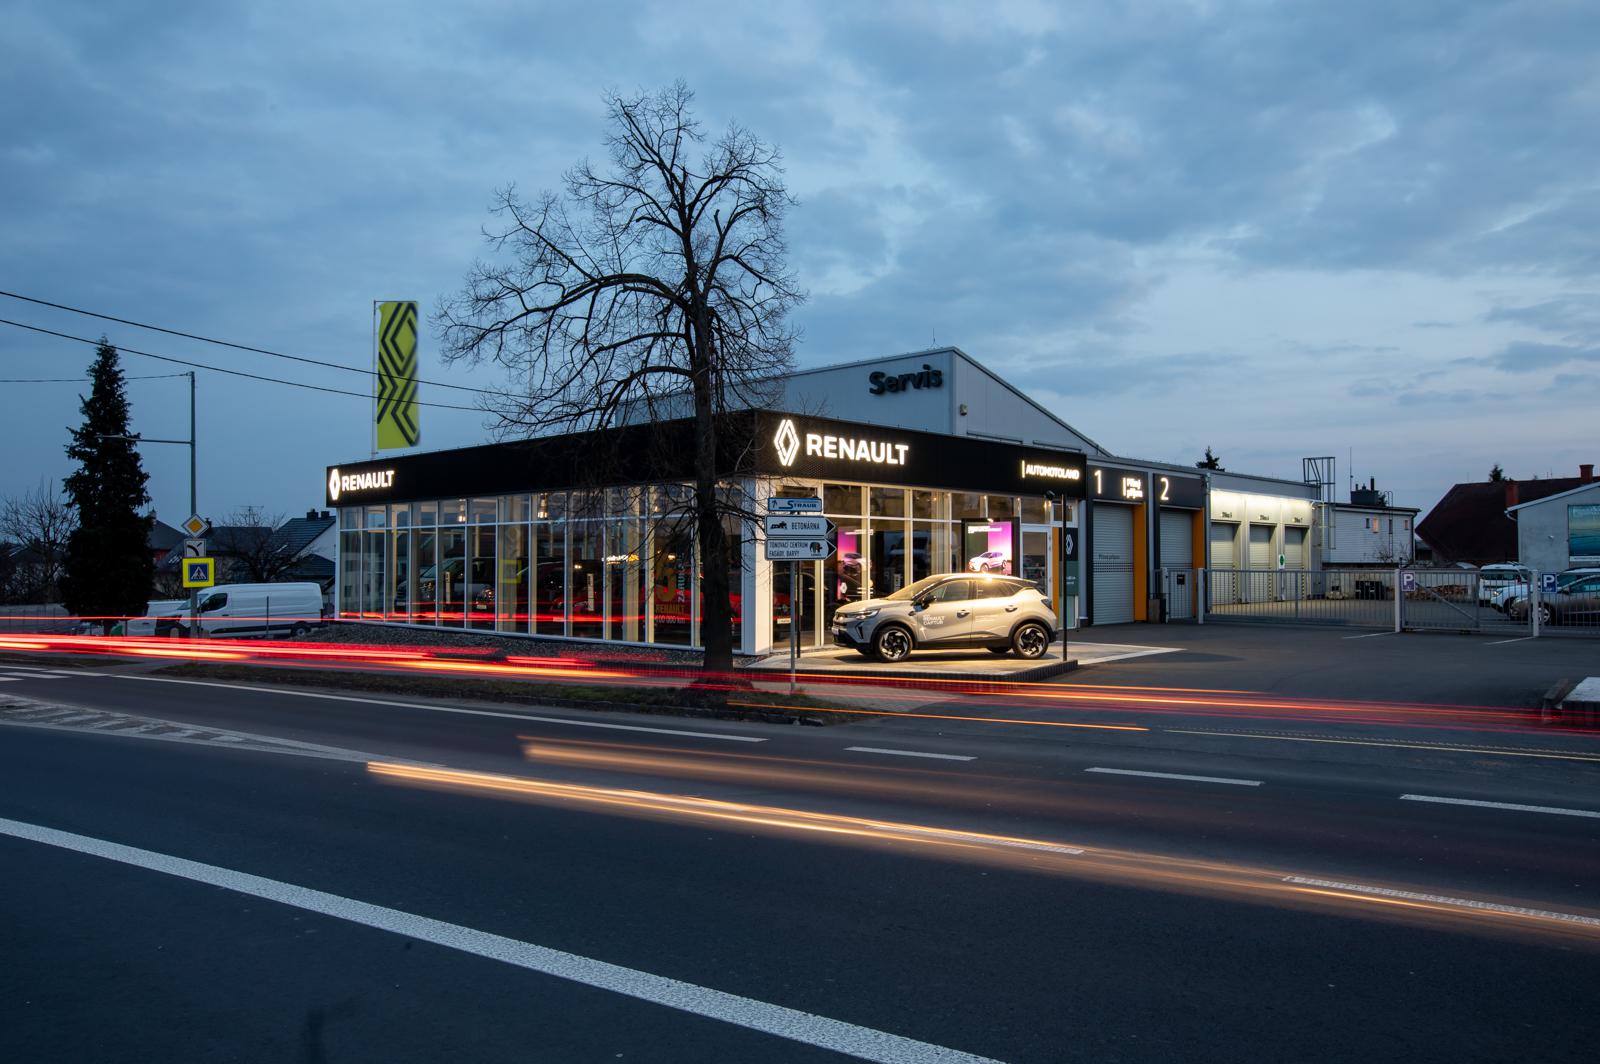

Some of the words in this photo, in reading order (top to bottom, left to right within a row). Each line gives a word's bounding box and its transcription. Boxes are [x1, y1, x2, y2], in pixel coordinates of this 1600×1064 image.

[869, 364, 943, 395] Servis
[806, 433, 909, 465] RENAULT
[341, 470, 395, 492] RENAULT
[1025, 464, 1080, 480] AUTOMOTOLAND
[1094, 469, 1103, 495] 1
[1160, 477, 1169, 501] 2
[1403, 574, 1413, 586] P
[1543, 575, 1555, 587] P
